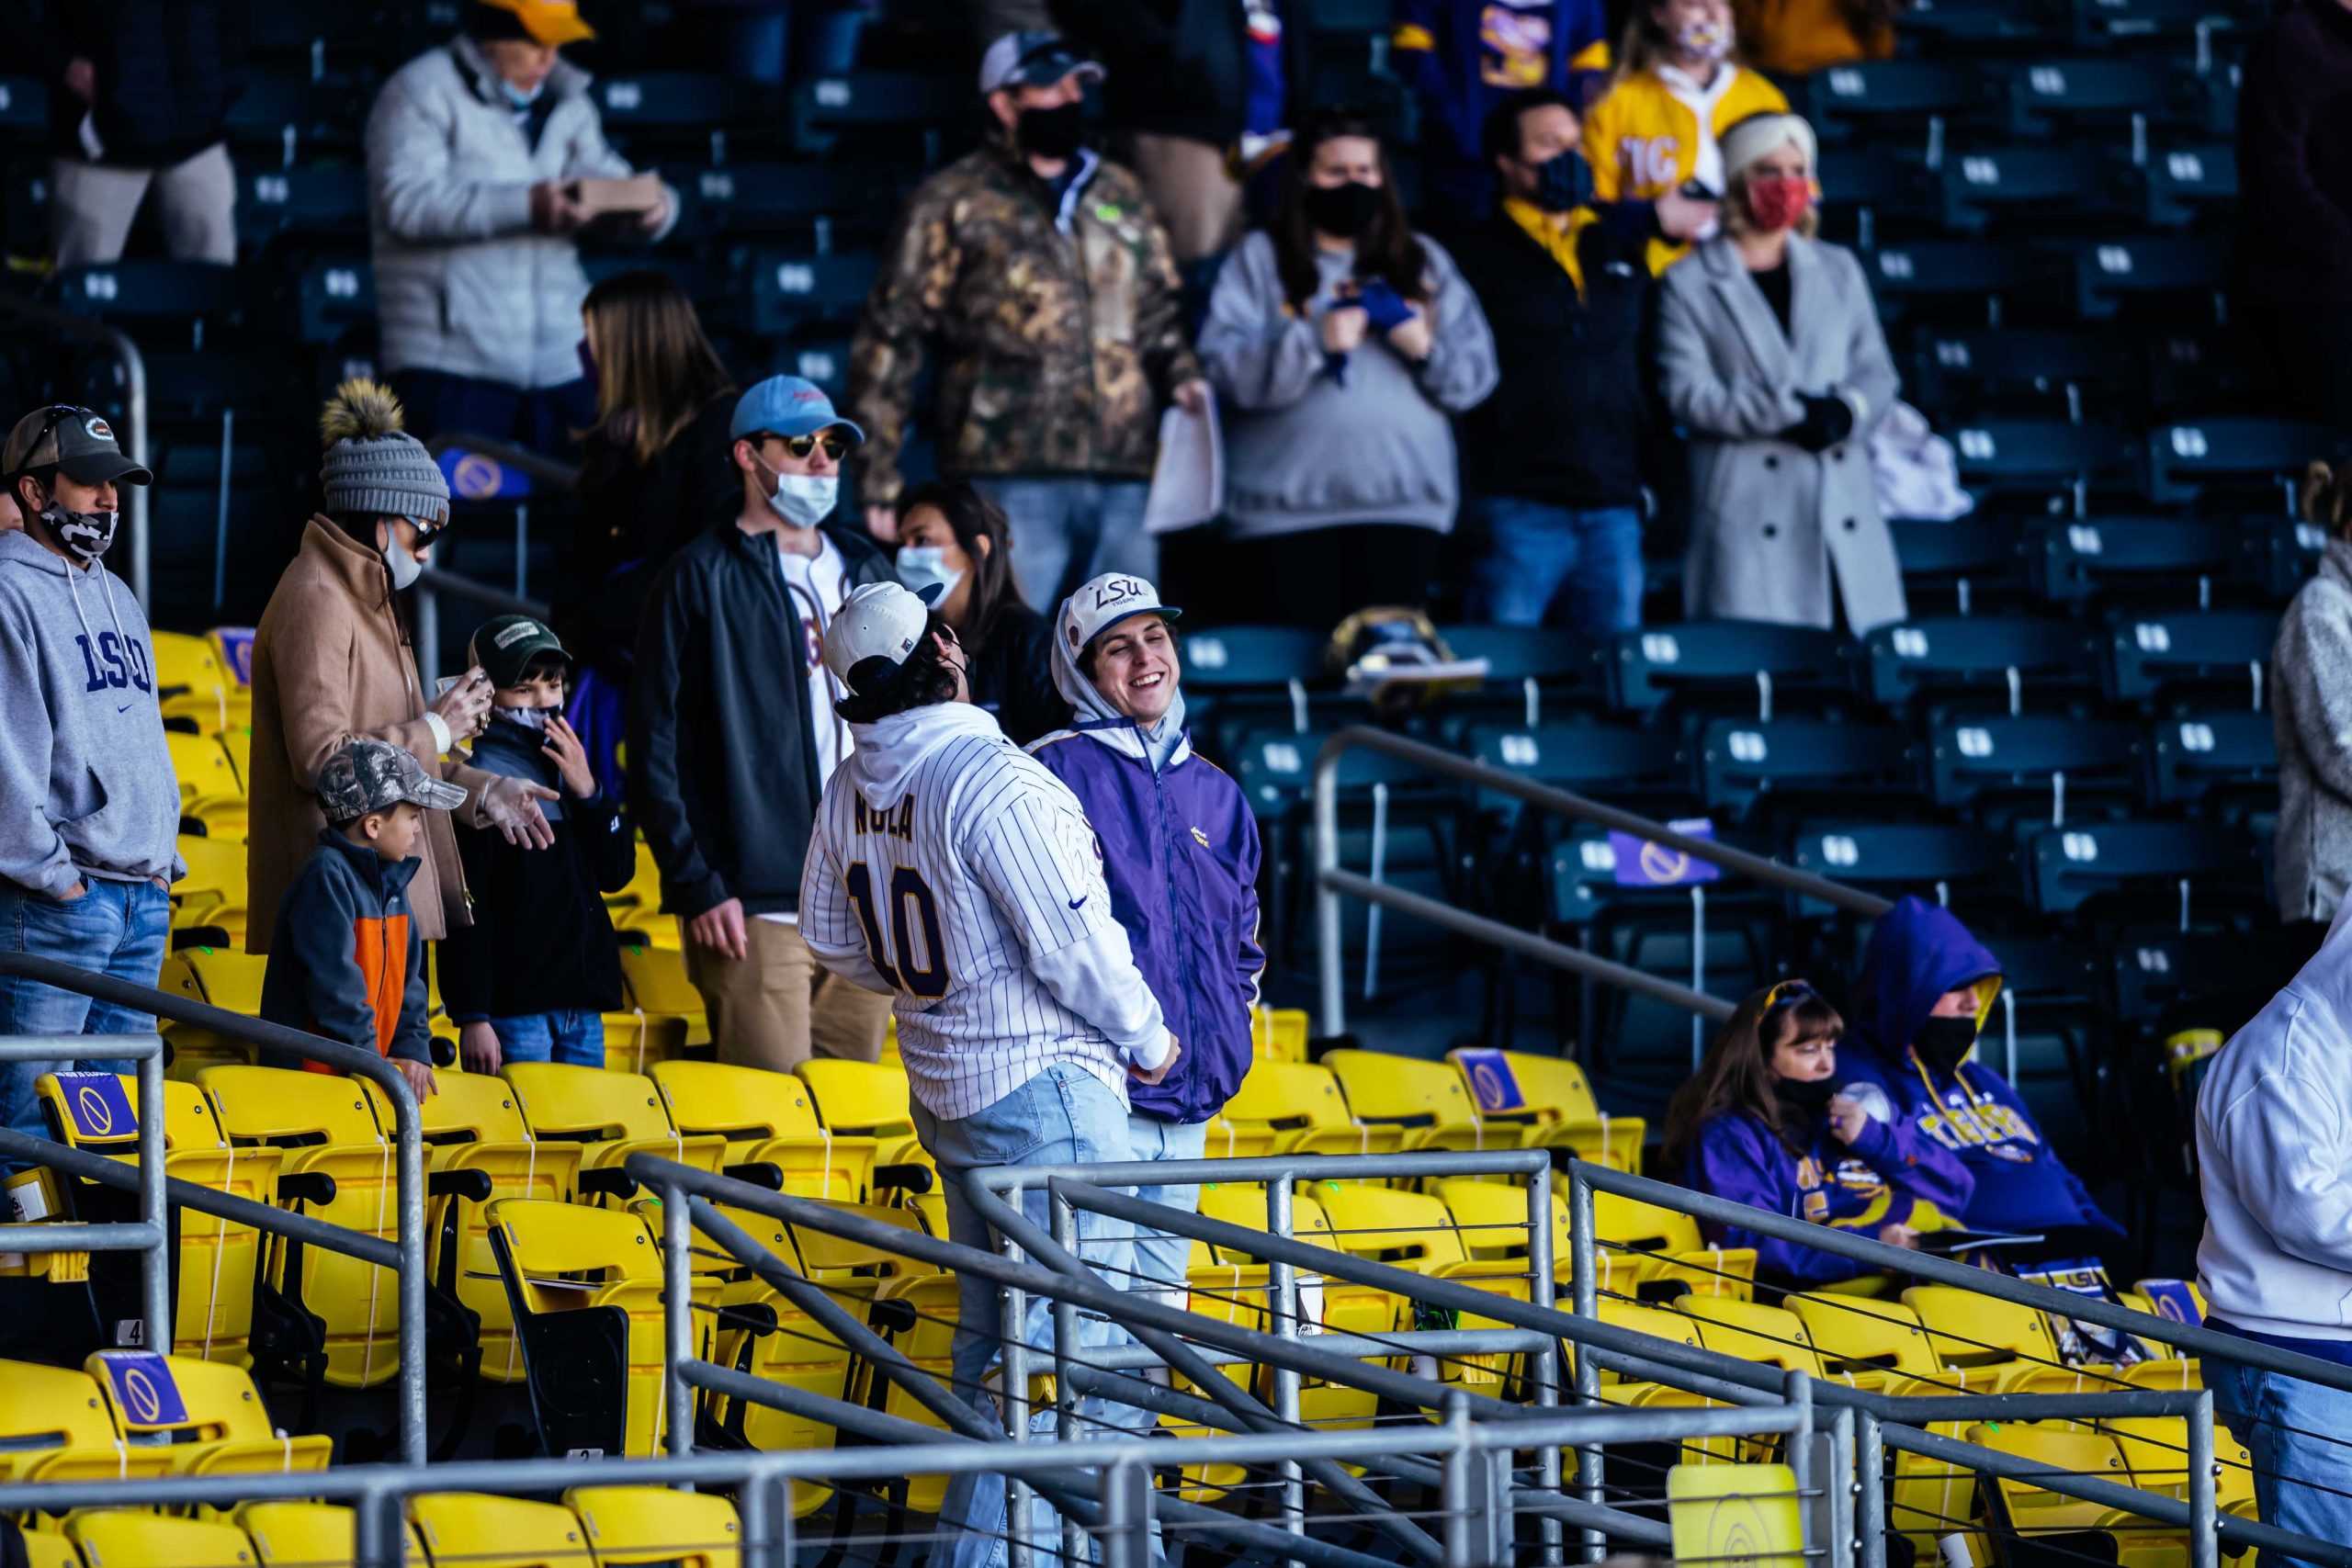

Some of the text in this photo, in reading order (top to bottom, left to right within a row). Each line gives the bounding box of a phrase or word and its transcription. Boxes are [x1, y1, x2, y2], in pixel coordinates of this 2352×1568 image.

[1095, 579, 1143, 611] LSU
[75, 631, 152, 696] LSU
[846, 860, 950, 999] 10
[129, 1320, 141, 1345] 4
